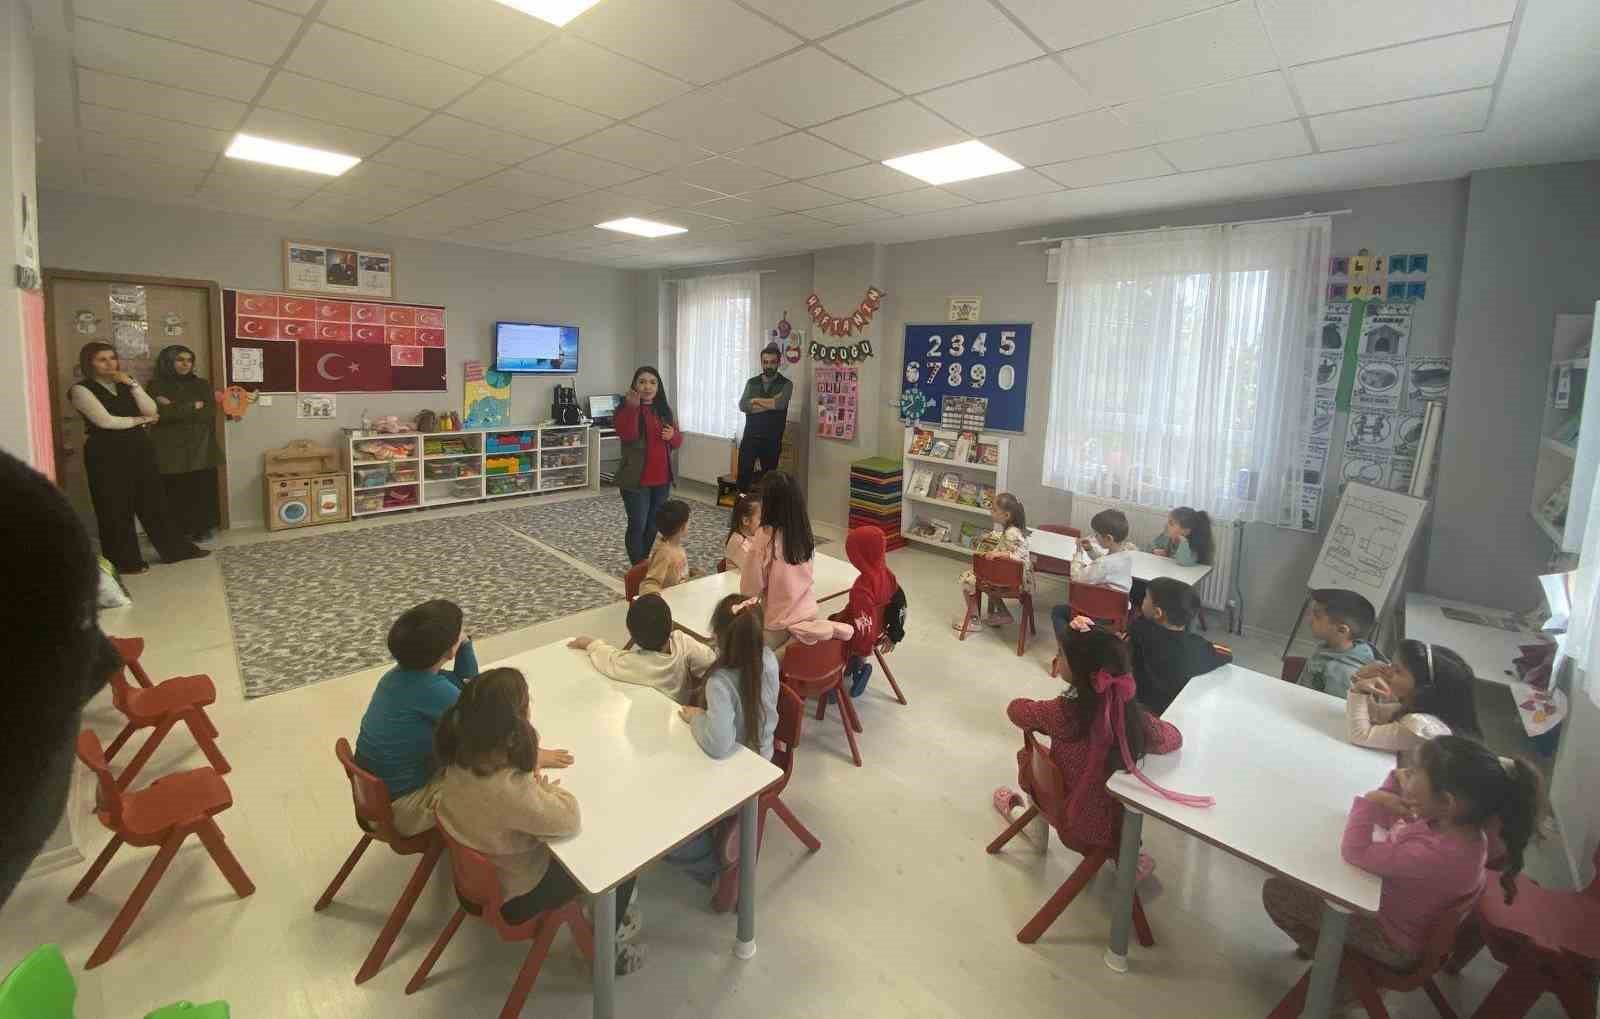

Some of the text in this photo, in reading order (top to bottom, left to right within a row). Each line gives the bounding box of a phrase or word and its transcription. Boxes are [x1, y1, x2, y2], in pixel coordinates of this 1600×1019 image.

[927, 331, 1016, 357] 2 3 4 5
[905, 361, 1015, 391] 6 7 8 9 0
